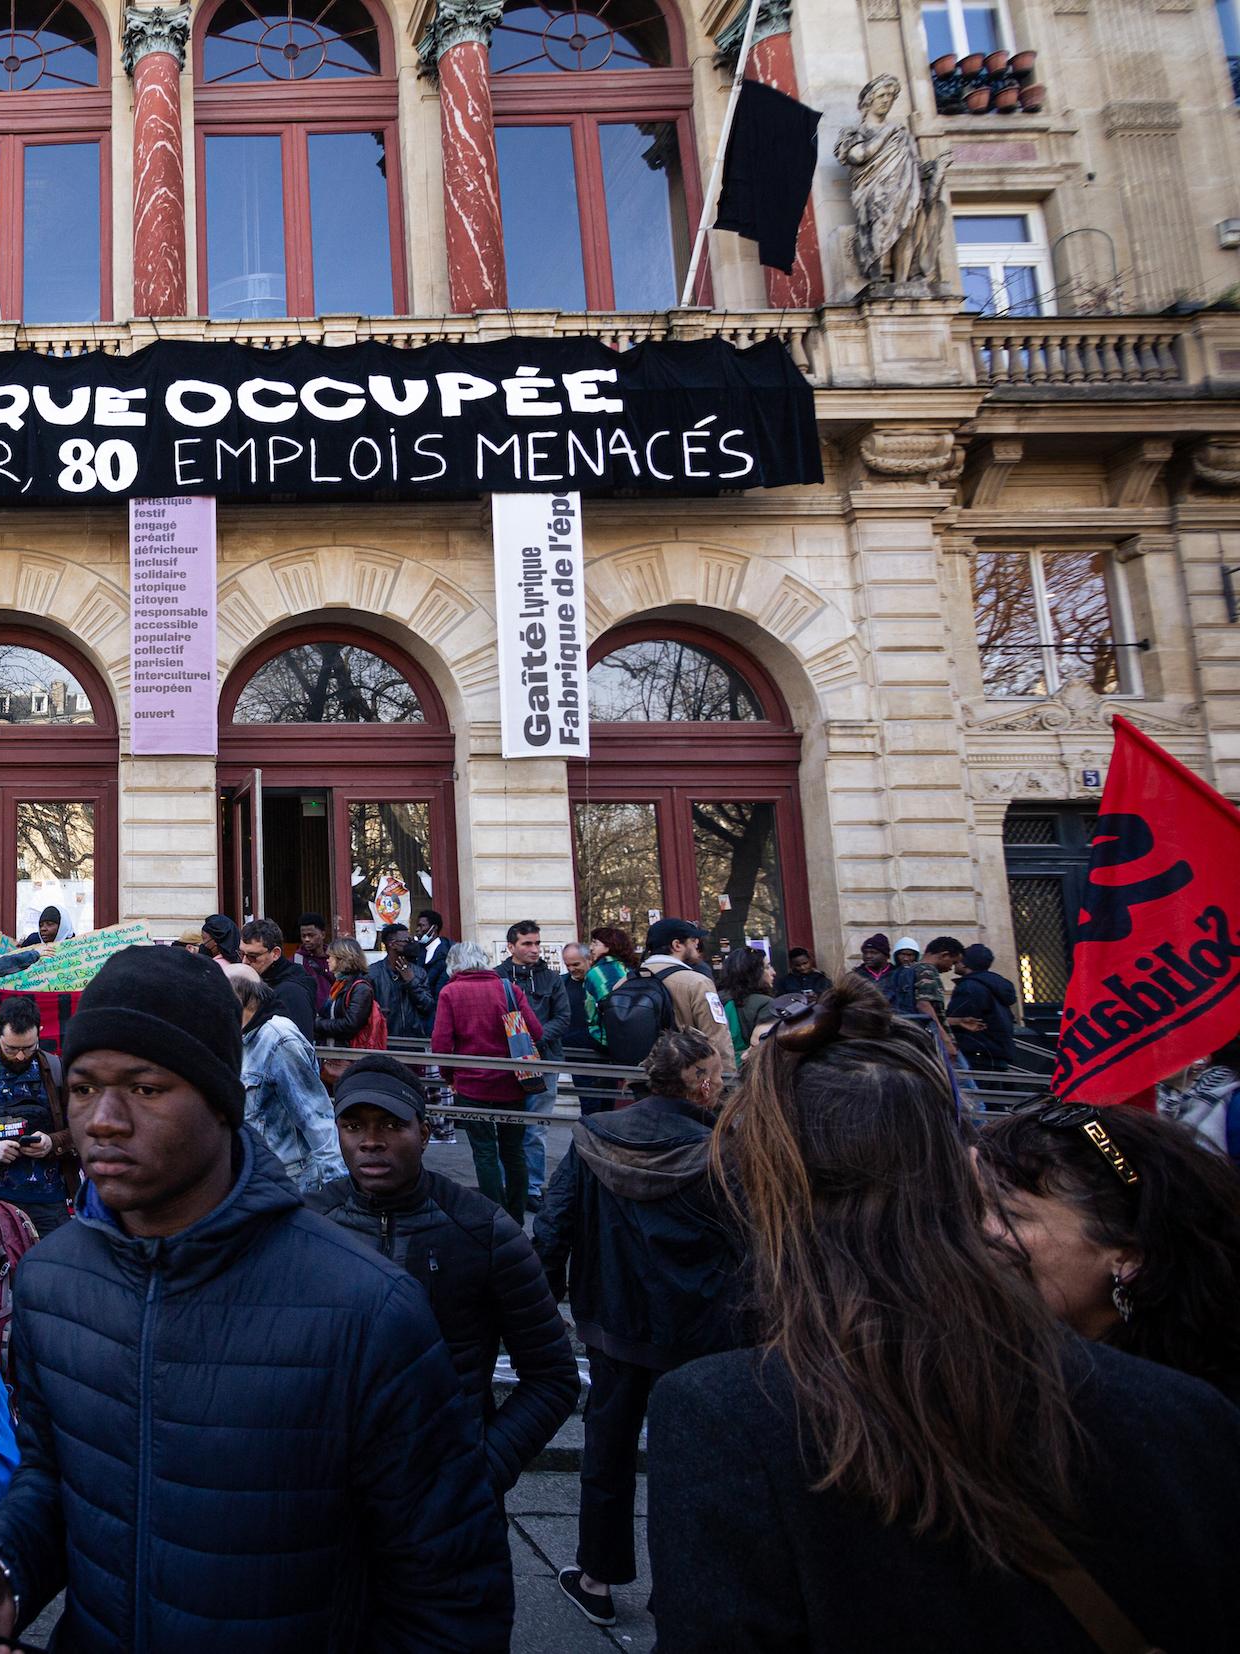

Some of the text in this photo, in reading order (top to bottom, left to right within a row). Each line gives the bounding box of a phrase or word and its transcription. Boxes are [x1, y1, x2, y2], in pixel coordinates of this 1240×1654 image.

[165, 366, 624, 428] OCCUPÉE
[57, 438, 139, 493] 80
[476, 414, 754, 482] MENACÉS
[134, 508, 166, 518] festif
[134, 520, 177, 531] engagé
[134, 533, 175, 543] créatif
[134, 545, 198, 555] défricheur
[134, 557, 178, 567] inclusif
[134, 570, 187, 580] solidaire
[550, 558, 574, 597] de
[134, 582, 186, 593] utopique
[134, 595, 178, 606] citoyen
[134, 607, 208, 618] responsable
[134, 619, 198, 630] accessible
[134, 632, 191, 644] populaire
[134, 645, 184, 655] collectif
[517, 546, 552, 748] Gaîté Lyrique
[134, 657, 184, 669] parisien
[134, 670, 211, 680] interculturel
[554, 603, 581, 746] Fabrique
[134, 683, 192, 694] européen
[134, 709, 175, 719] ouvert
[1085, 770, 1098, 787] 5
